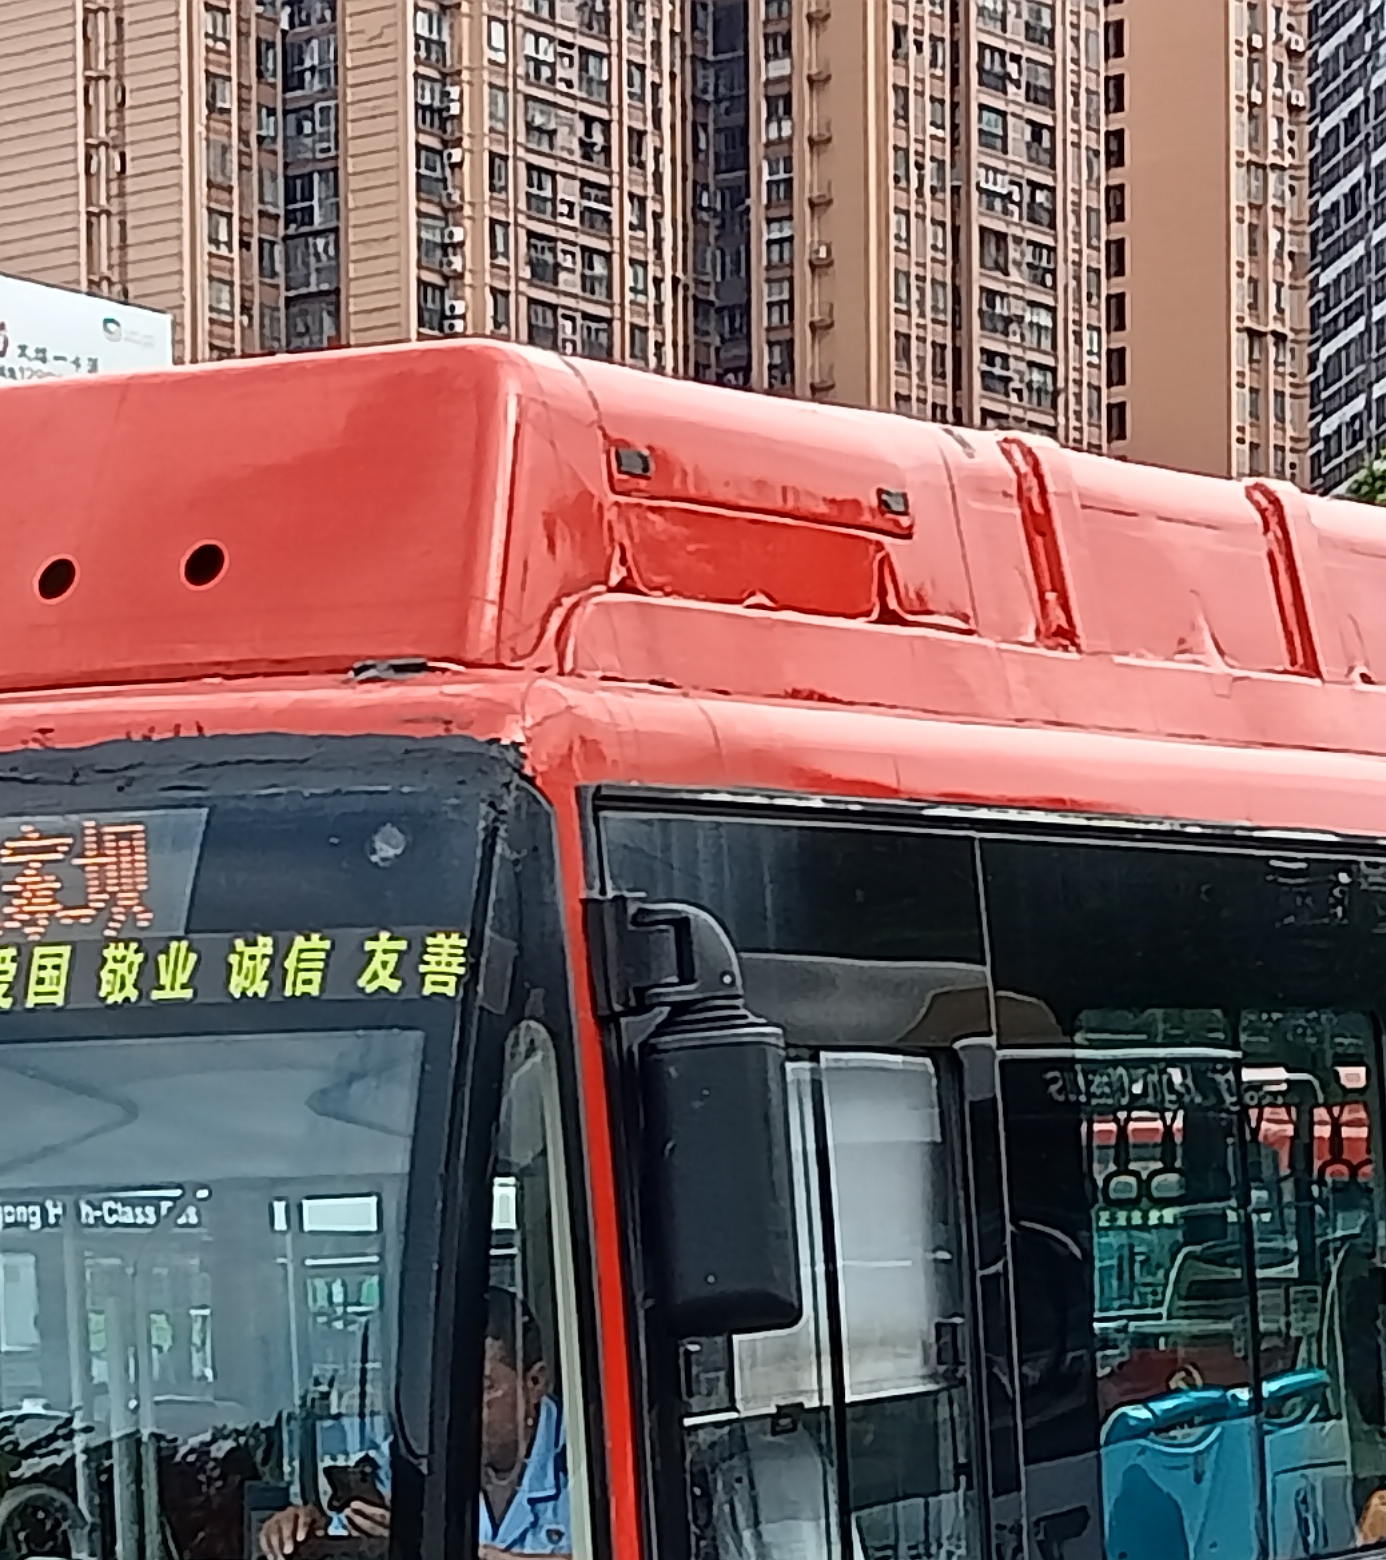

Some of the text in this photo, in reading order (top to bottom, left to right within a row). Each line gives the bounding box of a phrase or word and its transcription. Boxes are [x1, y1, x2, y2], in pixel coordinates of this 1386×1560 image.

[98, 940, 199, 1004] 敬业
[226, 934, 332, 1000] 诚信
[356, 930, 469, 998] 友善
[45, 1198, 158, 1227] Hh-Class
